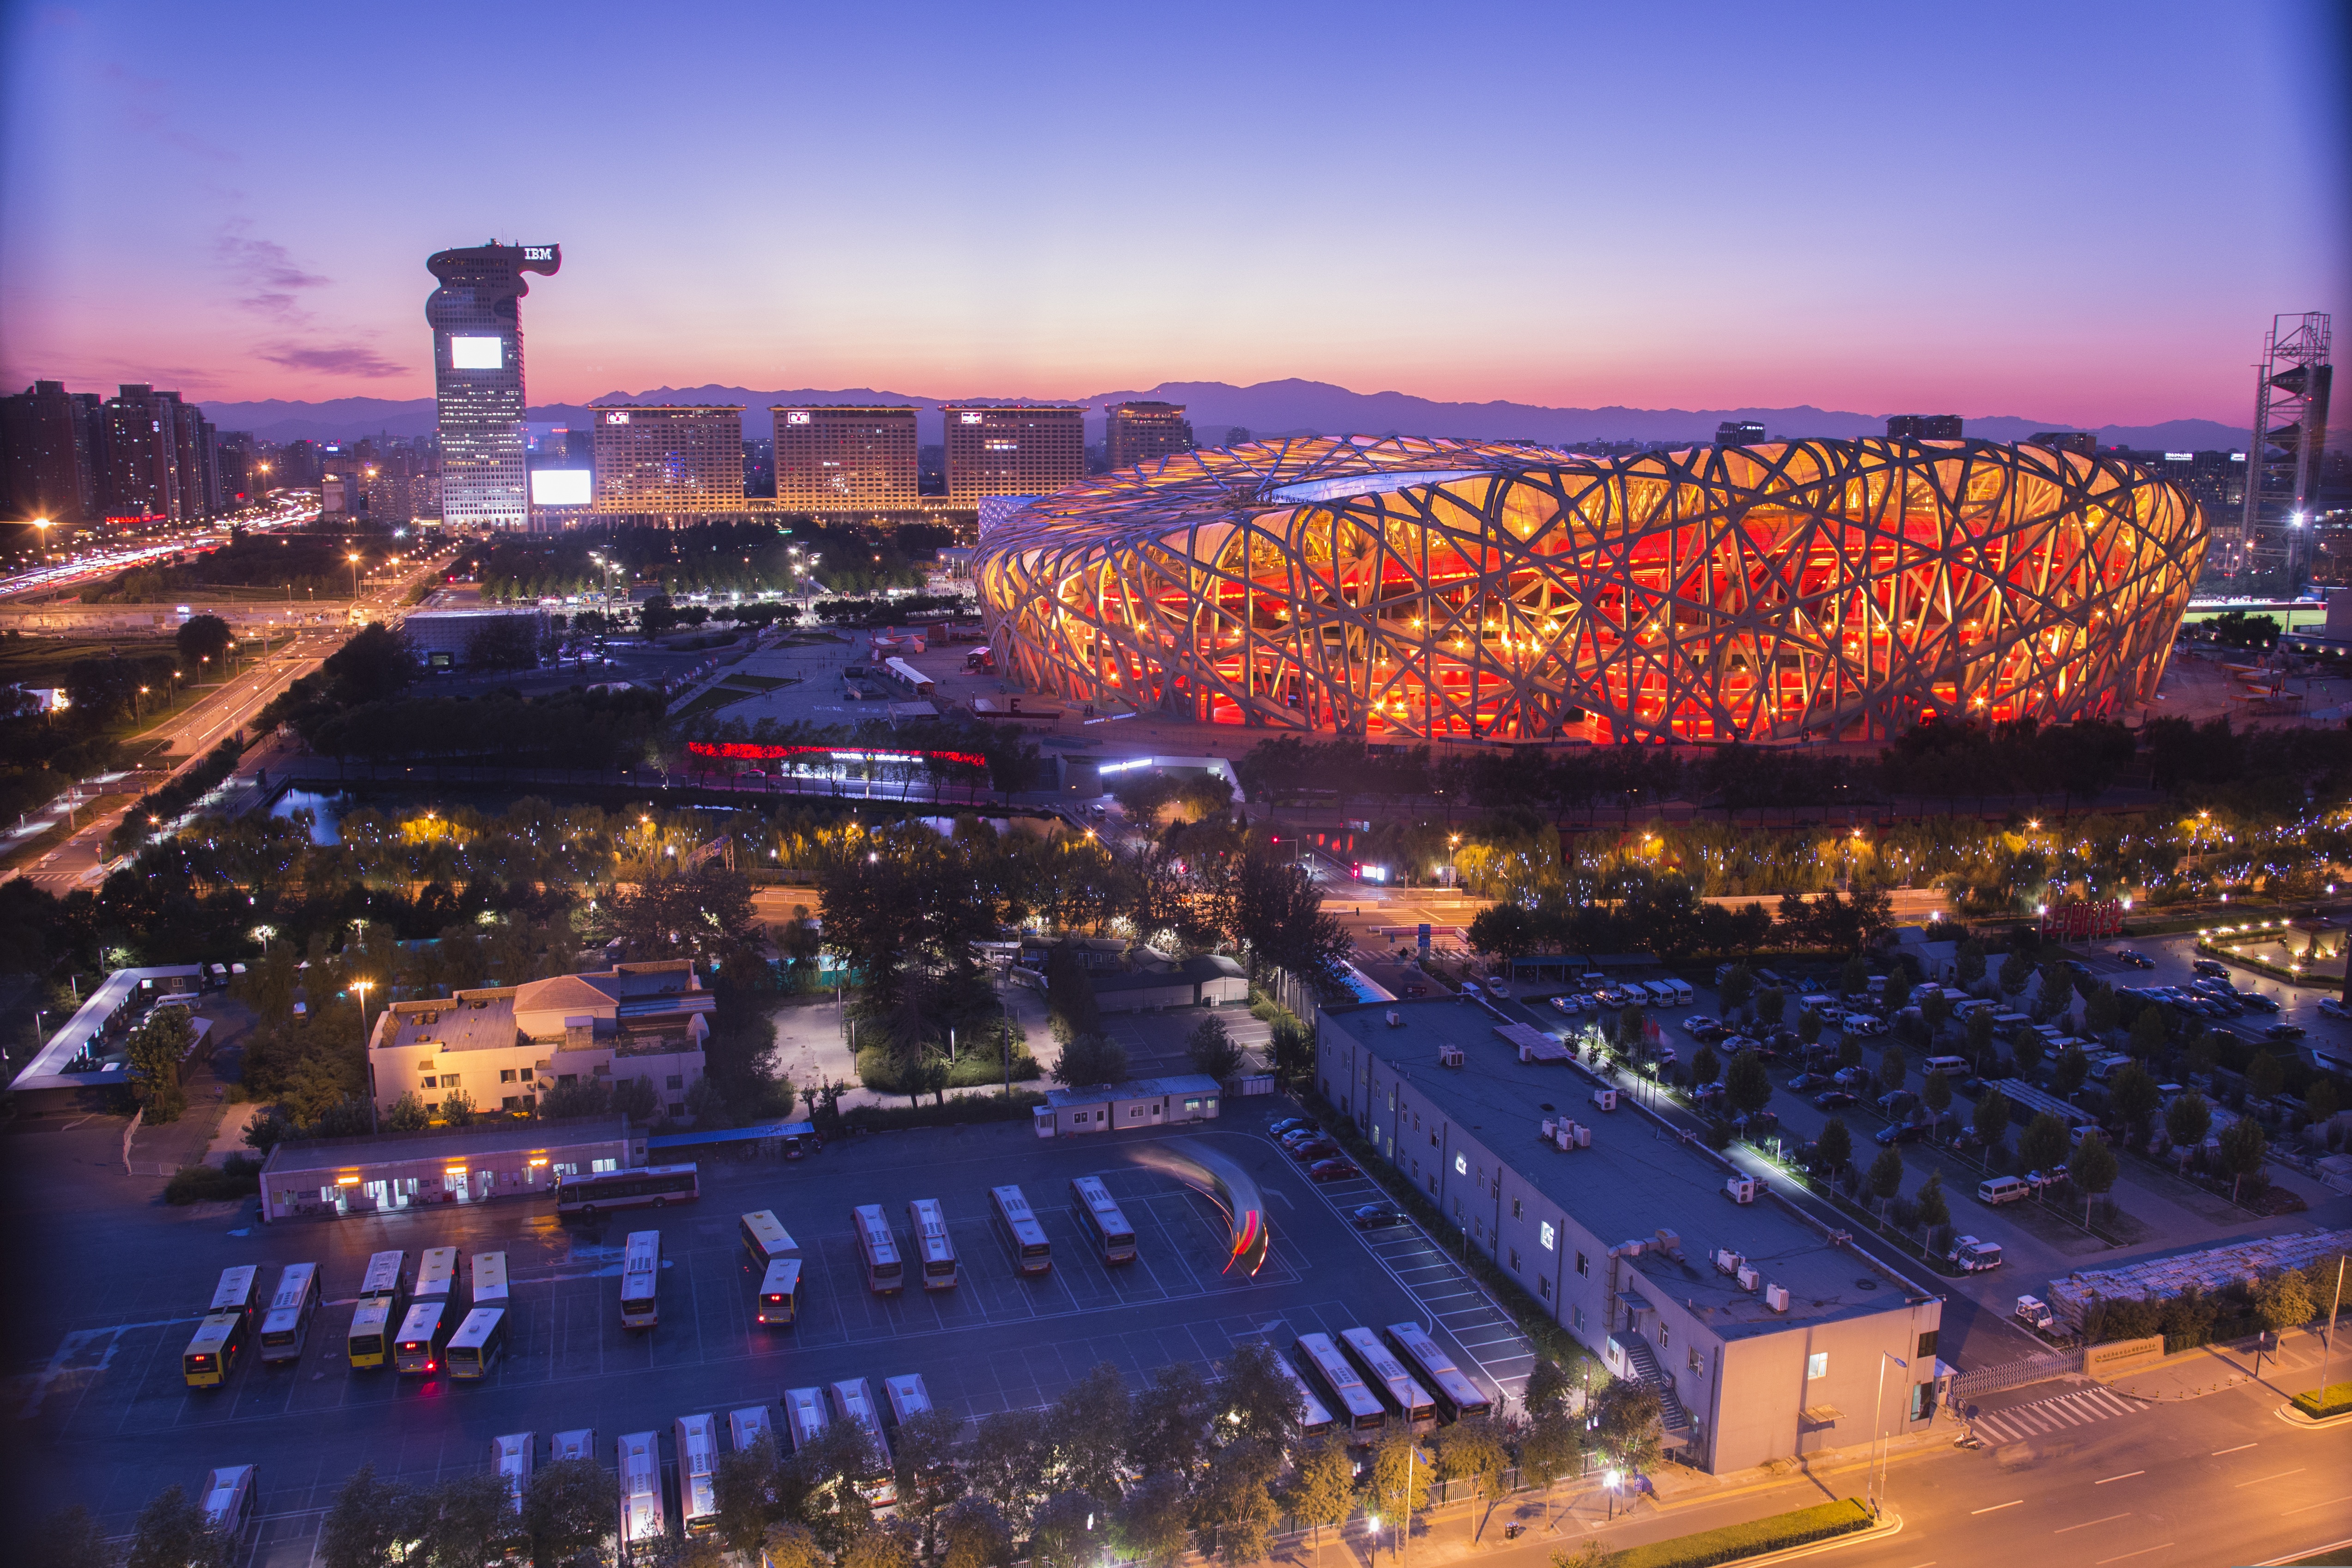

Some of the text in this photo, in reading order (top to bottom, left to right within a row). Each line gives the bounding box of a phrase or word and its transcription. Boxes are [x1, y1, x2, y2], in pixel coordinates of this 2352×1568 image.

[525, 248, 552, 259] IBM
[1010, 698, 1021, 712] E
[1472, 724, 1483, 740] E
[1552, 725, 1562, 742] F
[1801, 726, 1809, 742] G
[2042, 898, 2123, 939] 中航技
